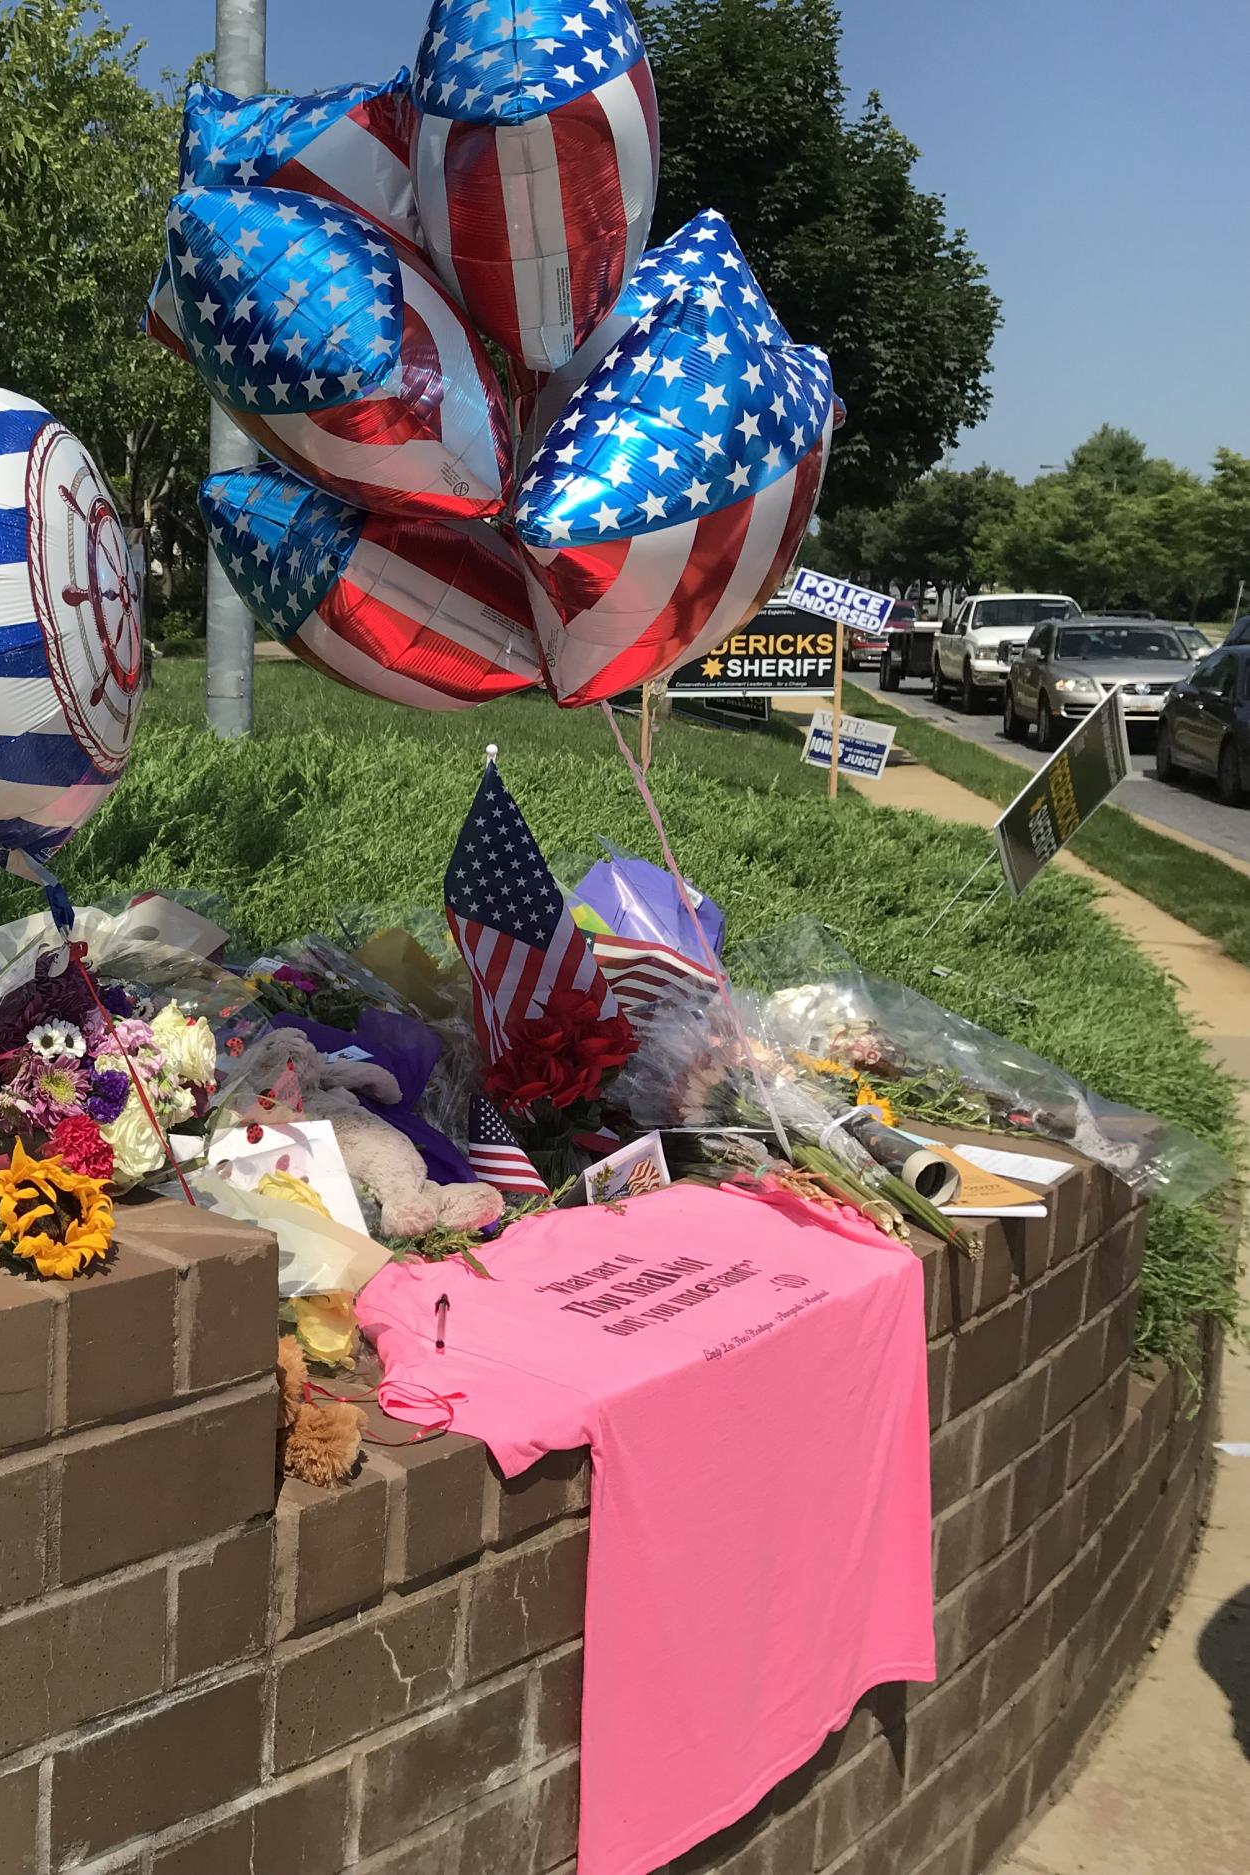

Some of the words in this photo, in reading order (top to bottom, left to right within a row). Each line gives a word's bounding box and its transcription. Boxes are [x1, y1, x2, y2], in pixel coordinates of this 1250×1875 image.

[799, 574, 885, 616] POLICE
[790, 589, 881, 631] ENDORSED
[710, 633, 834, 656] DERICKS
[726, 657, 833, 678] SHERIFF
[810, 735, 845, 758] JONS
[843, 753, 880, 770] JUDGE
[1028, 804, 1058, 864] SHERIFF
[582, 1261, 629, 1280] part
[559, 1293, 637, 1318] Thou
[610, 1268, 684, 1298] Shall
[656, 1255, 714, 1276] Not
[601, 1314, 658, 1336] don't
[640, 1303, 685, 1323] you
